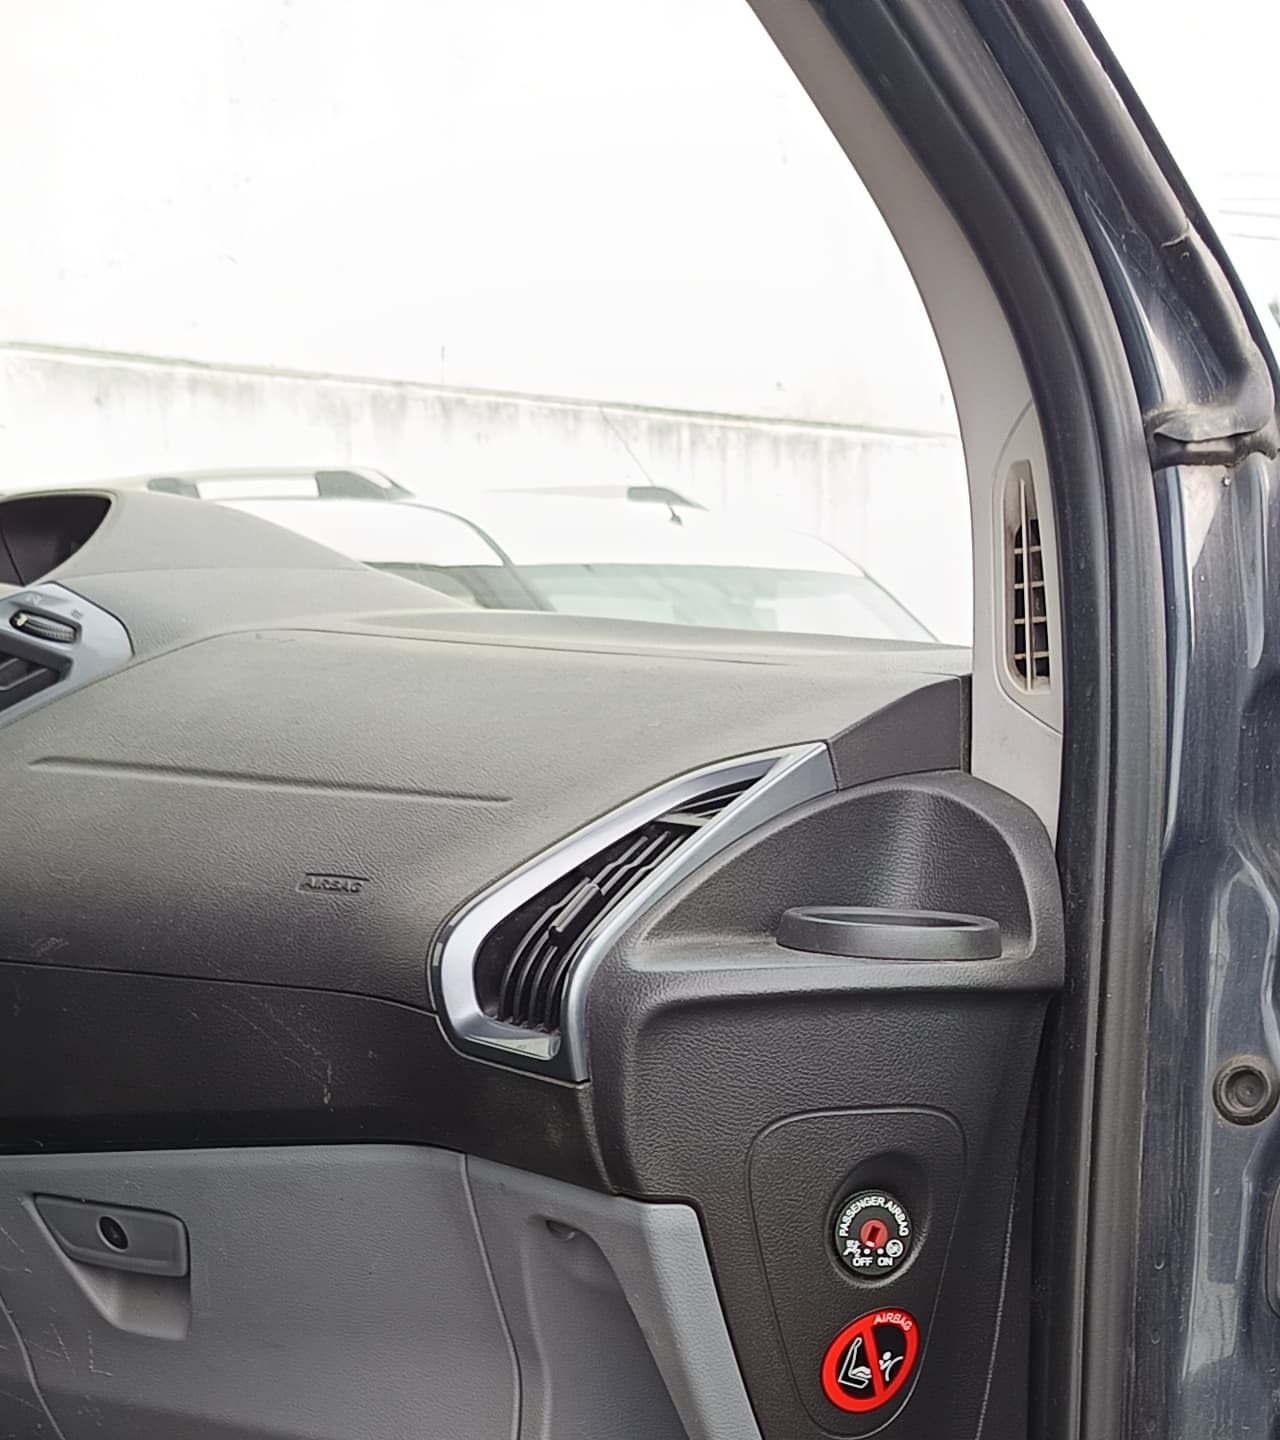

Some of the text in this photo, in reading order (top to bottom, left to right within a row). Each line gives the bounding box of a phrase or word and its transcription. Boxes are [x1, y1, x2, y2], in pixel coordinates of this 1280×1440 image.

[839, 1196, 910, 1237] PASSENGER AIRBAG
[852, 1257, 893, 1267] OFF ON
[873, 1312, 913, 1332] AIRBAG
